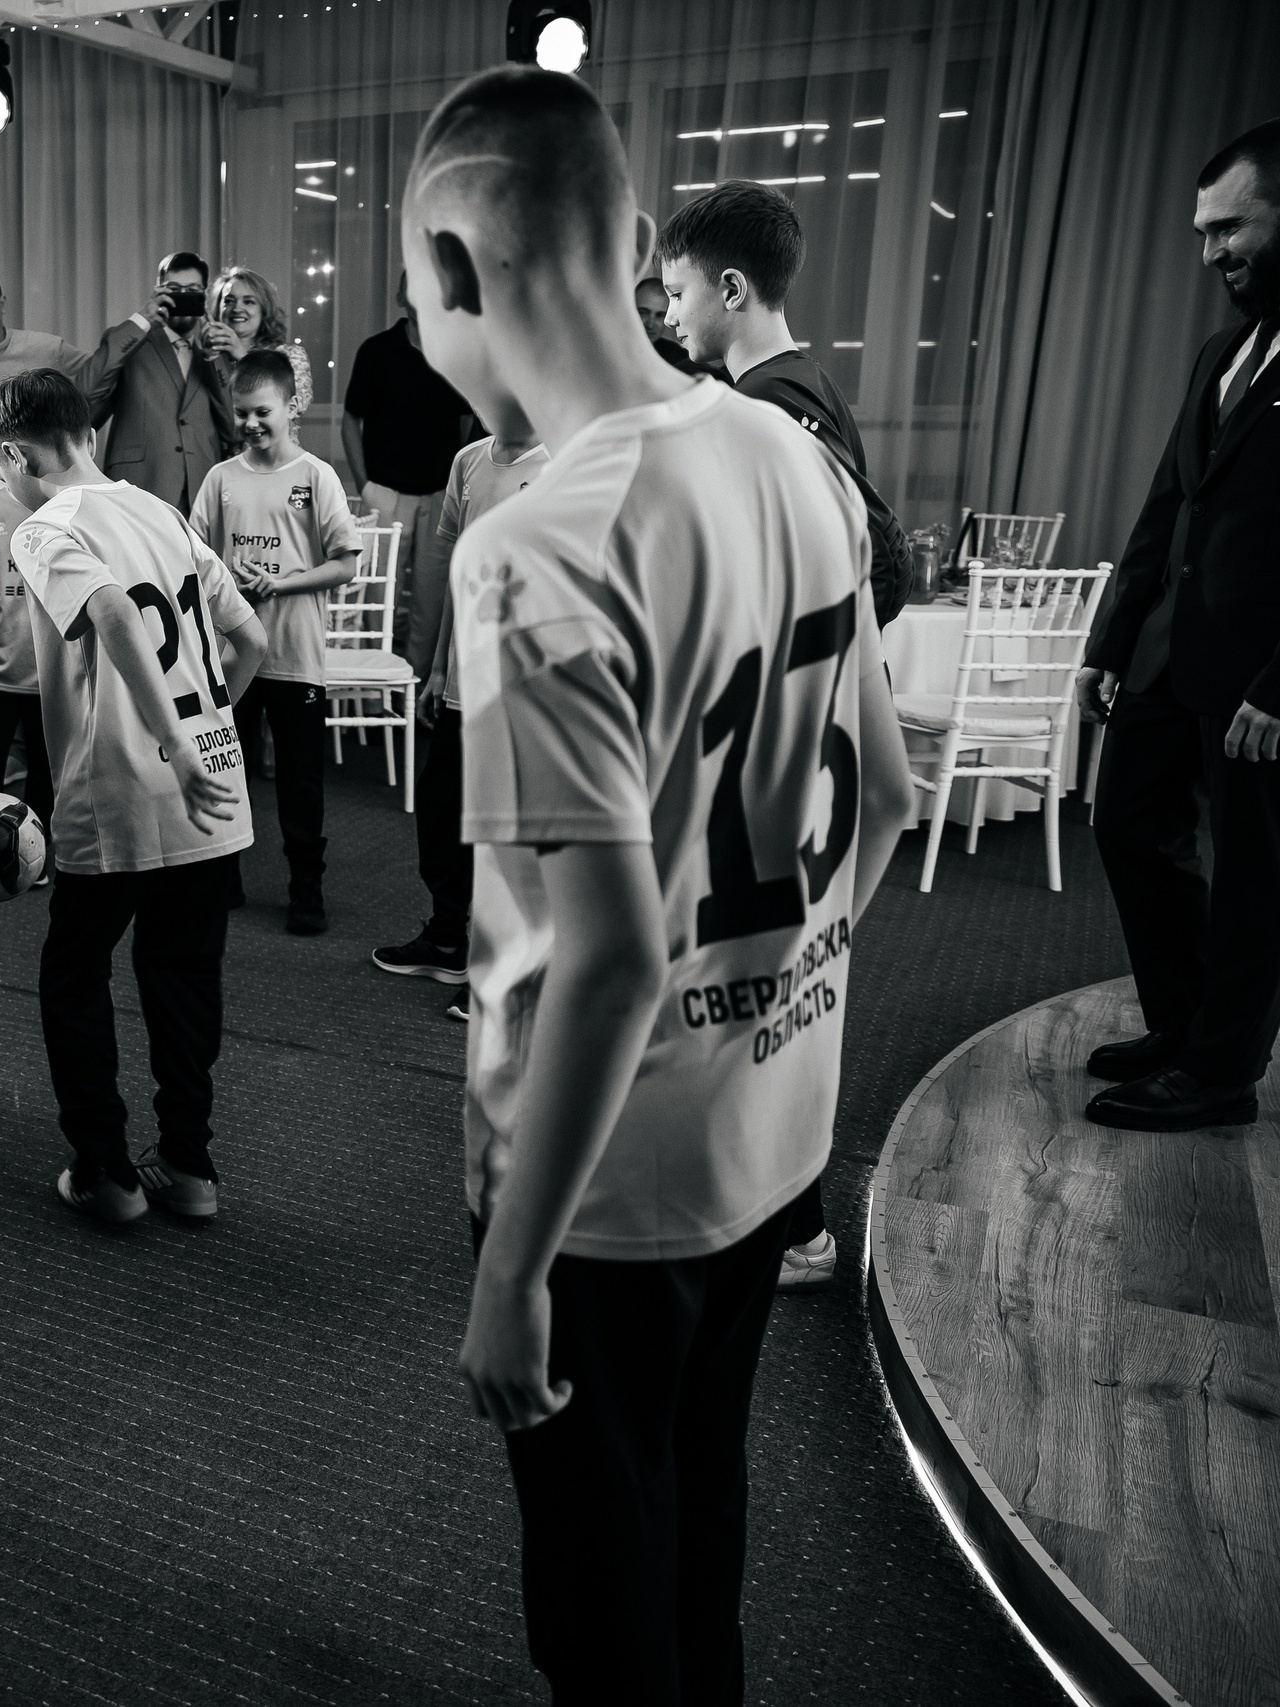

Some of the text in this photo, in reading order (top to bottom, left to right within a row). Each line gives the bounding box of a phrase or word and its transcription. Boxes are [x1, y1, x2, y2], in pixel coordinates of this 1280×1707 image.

[126, 573, 231, 720] 21
[202, 748, 242, 775] БЛАСТЬ
[683, 916, 851, 1028] СВЕРДЛОВСКА
